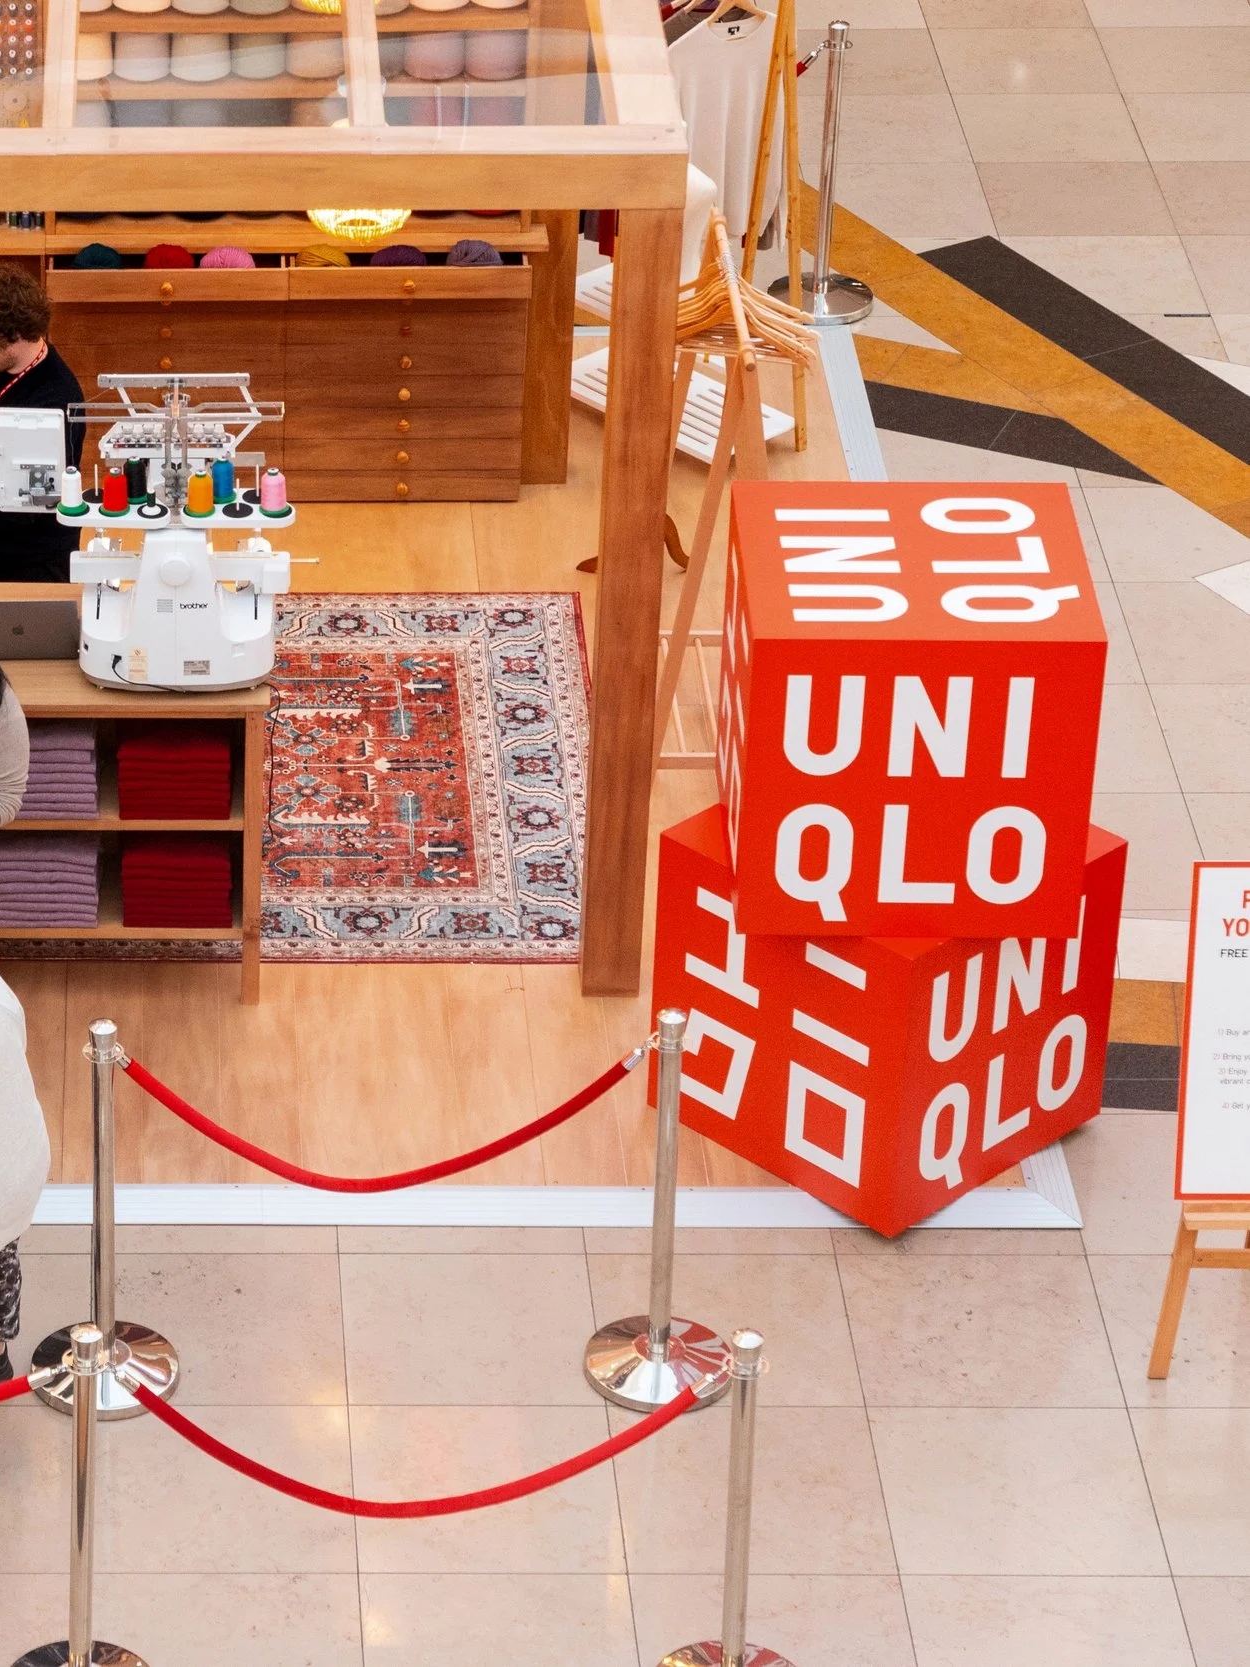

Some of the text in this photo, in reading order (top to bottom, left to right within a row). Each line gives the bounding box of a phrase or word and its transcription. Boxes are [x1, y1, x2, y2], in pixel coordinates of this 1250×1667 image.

[775, 509, 908, 621] UNI
[920, 498, 1080, 622] QLO
[783, 674, 1035, 779] UNI
[774, 803, 1047, 922] QLO
[928, 895, 1087, 1063] UNI
[1220, 948, 1249, 958] FREE
[1222, 1053, 1242, 1062] Bring
[1226, 1029, 1239, 1037] Buy
[1228, 1068, 1247, 1076] Enjoy
[919, 1014, 1088, 1190] QLO
